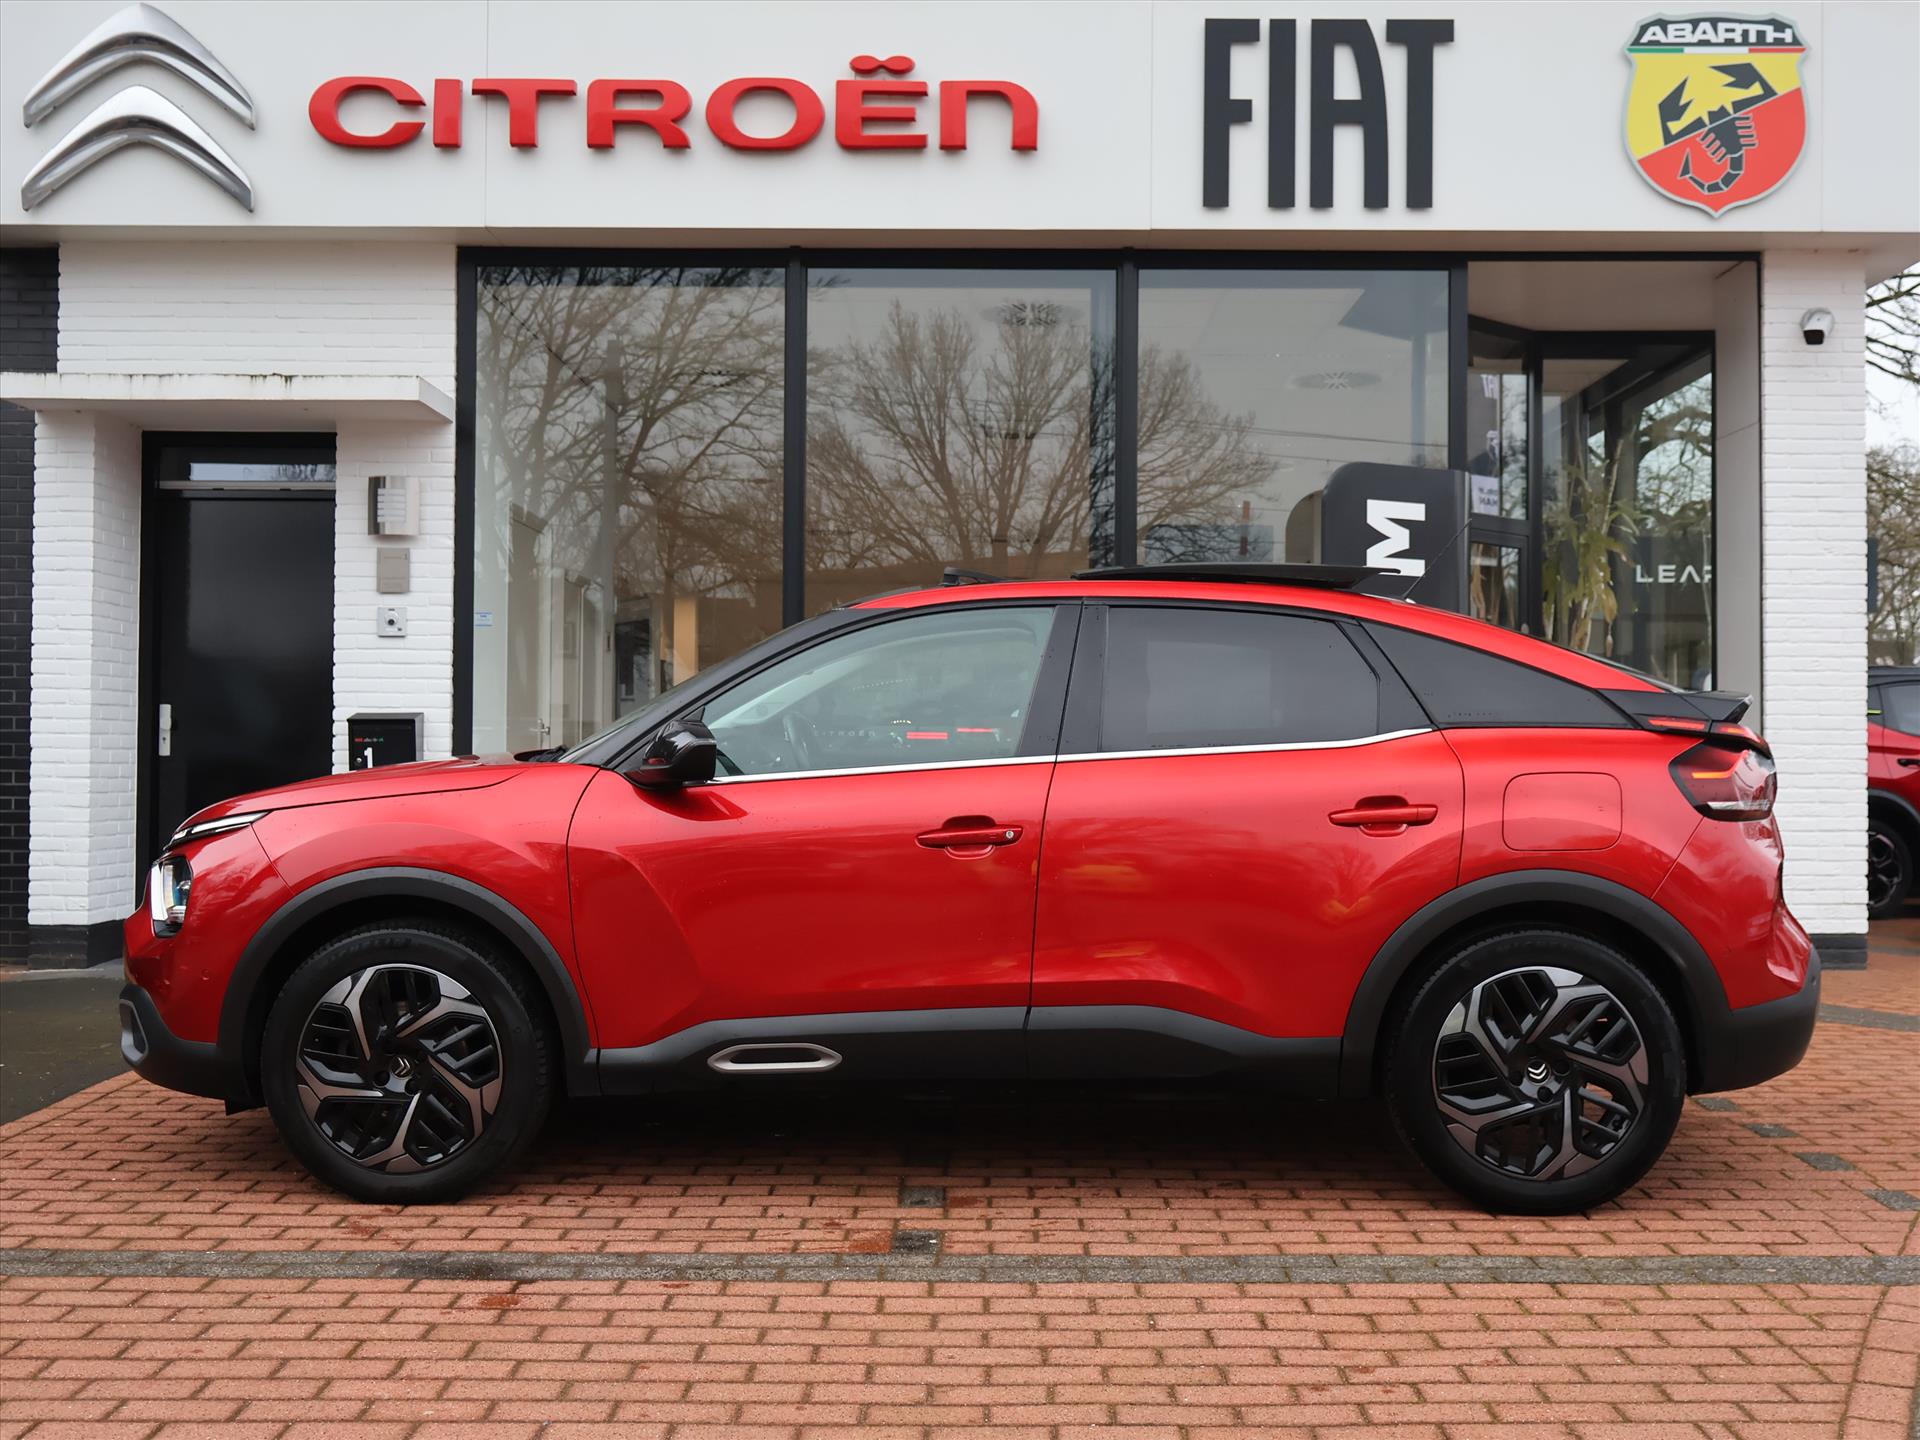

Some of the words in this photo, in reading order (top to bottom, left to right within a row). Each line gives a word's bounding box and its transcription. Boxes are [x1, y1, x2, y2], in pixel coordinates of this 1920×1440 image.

[1639, 21, 1794, 44] ABARTH
[309, 54, 1040, 152] CITROËN
[1203, 18, 1455, 210] FIAT
[364, 747, 373, 768] 1
